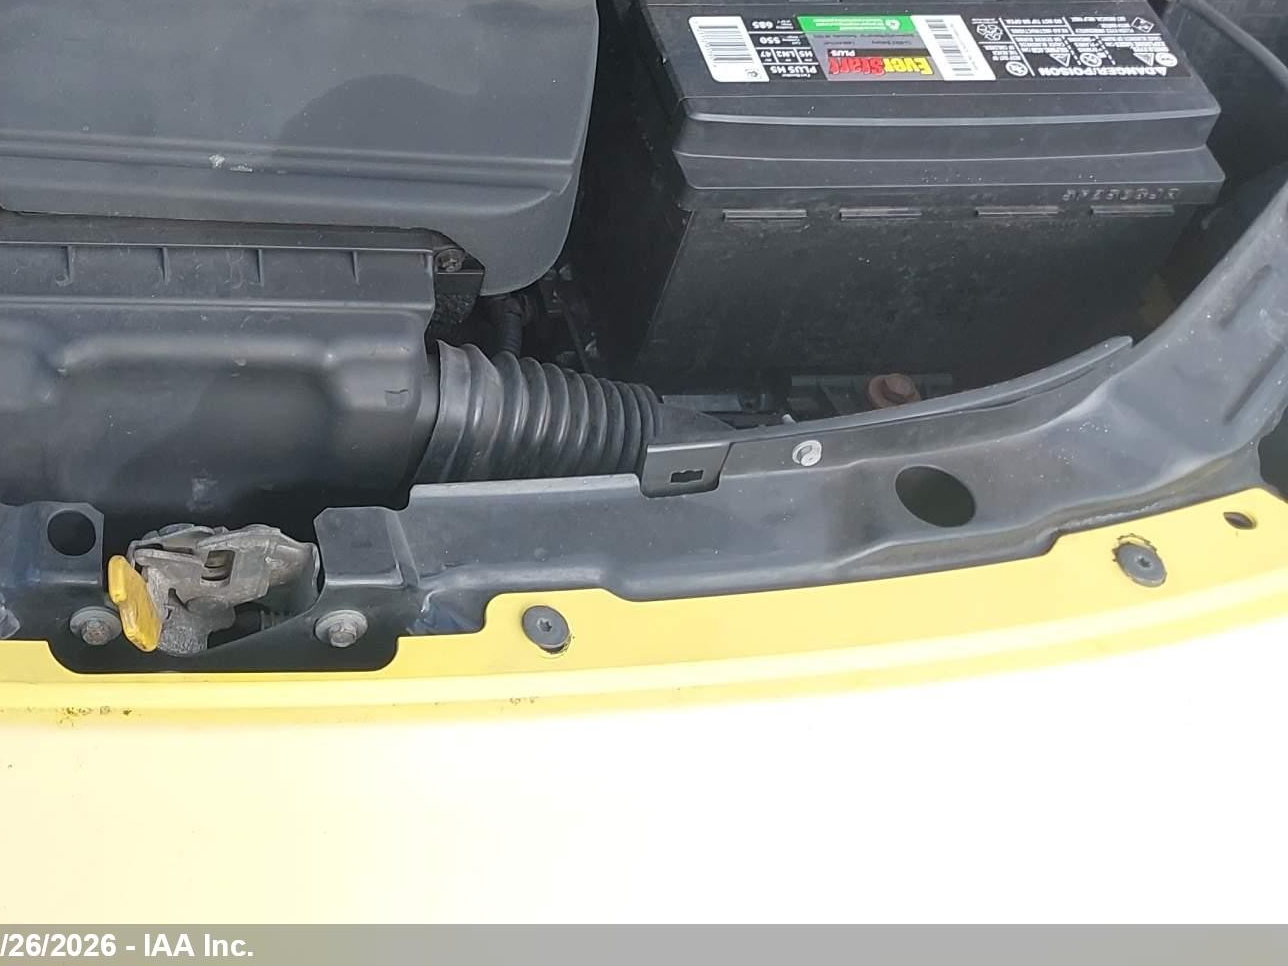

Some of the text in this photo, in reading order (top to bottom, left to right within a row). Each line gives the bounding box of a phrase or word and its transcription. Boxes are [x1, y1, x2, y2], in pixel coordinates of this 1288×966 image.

[752, 21, 773, 29] 685
[759, 36, 781, 44] 550
[776, 50, 795, 58] LN2
[770, 65, 817, 74] PLUS H5
[828, 57, 933, 75] EverStart
[1038, 66, 1157, 76] DANGER/POISON
